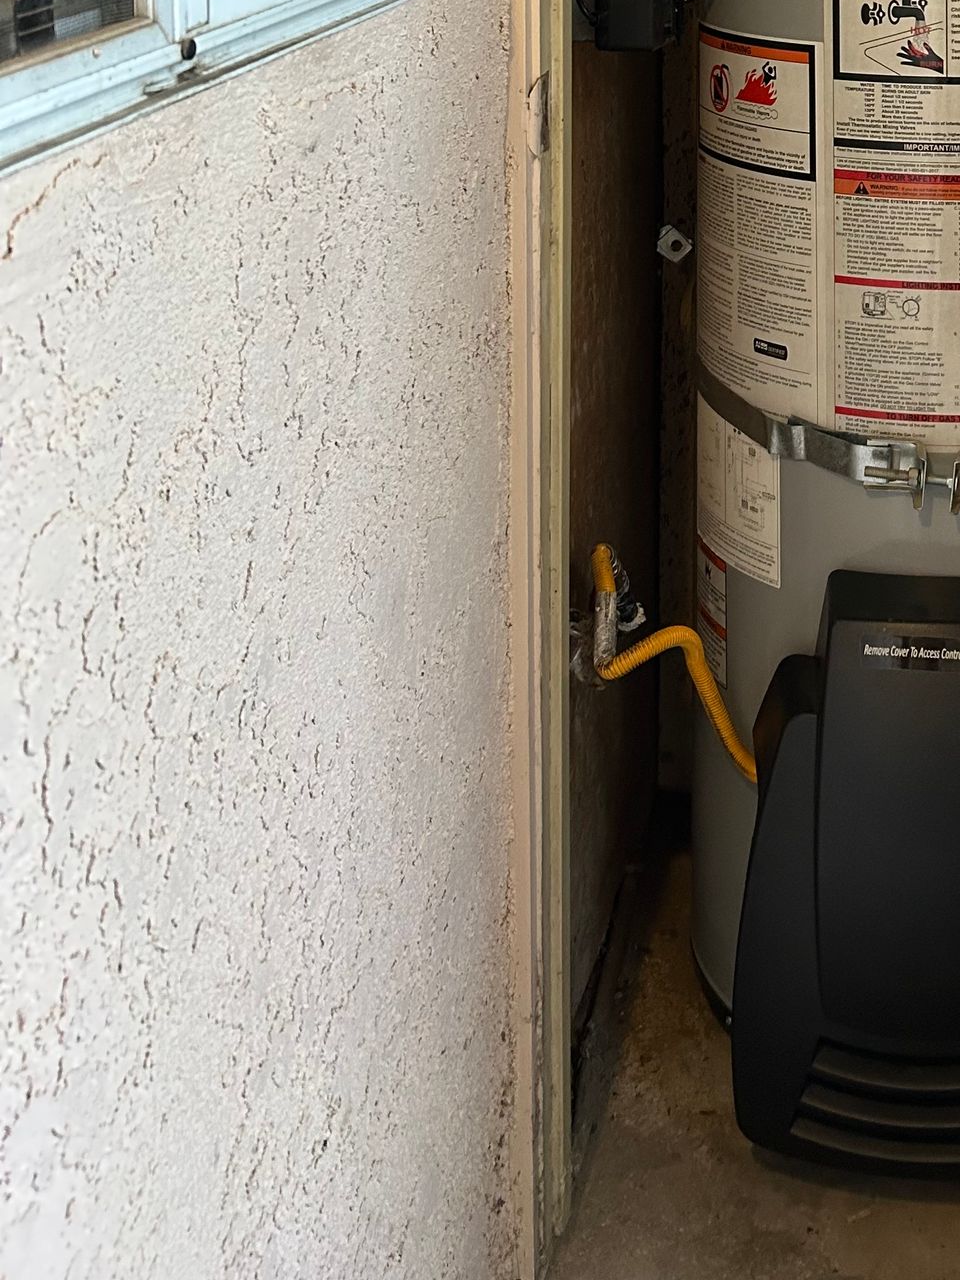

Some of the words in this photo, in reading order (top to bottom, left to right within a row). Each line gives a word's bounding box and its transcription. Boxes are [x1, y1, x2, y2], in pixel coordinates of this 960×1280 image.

[863, 644, 890, 657] Remove
[890, 645, 909, 658] Cover
[910, 646, 918, 657] To
[918, 647, 940, 659] Access
